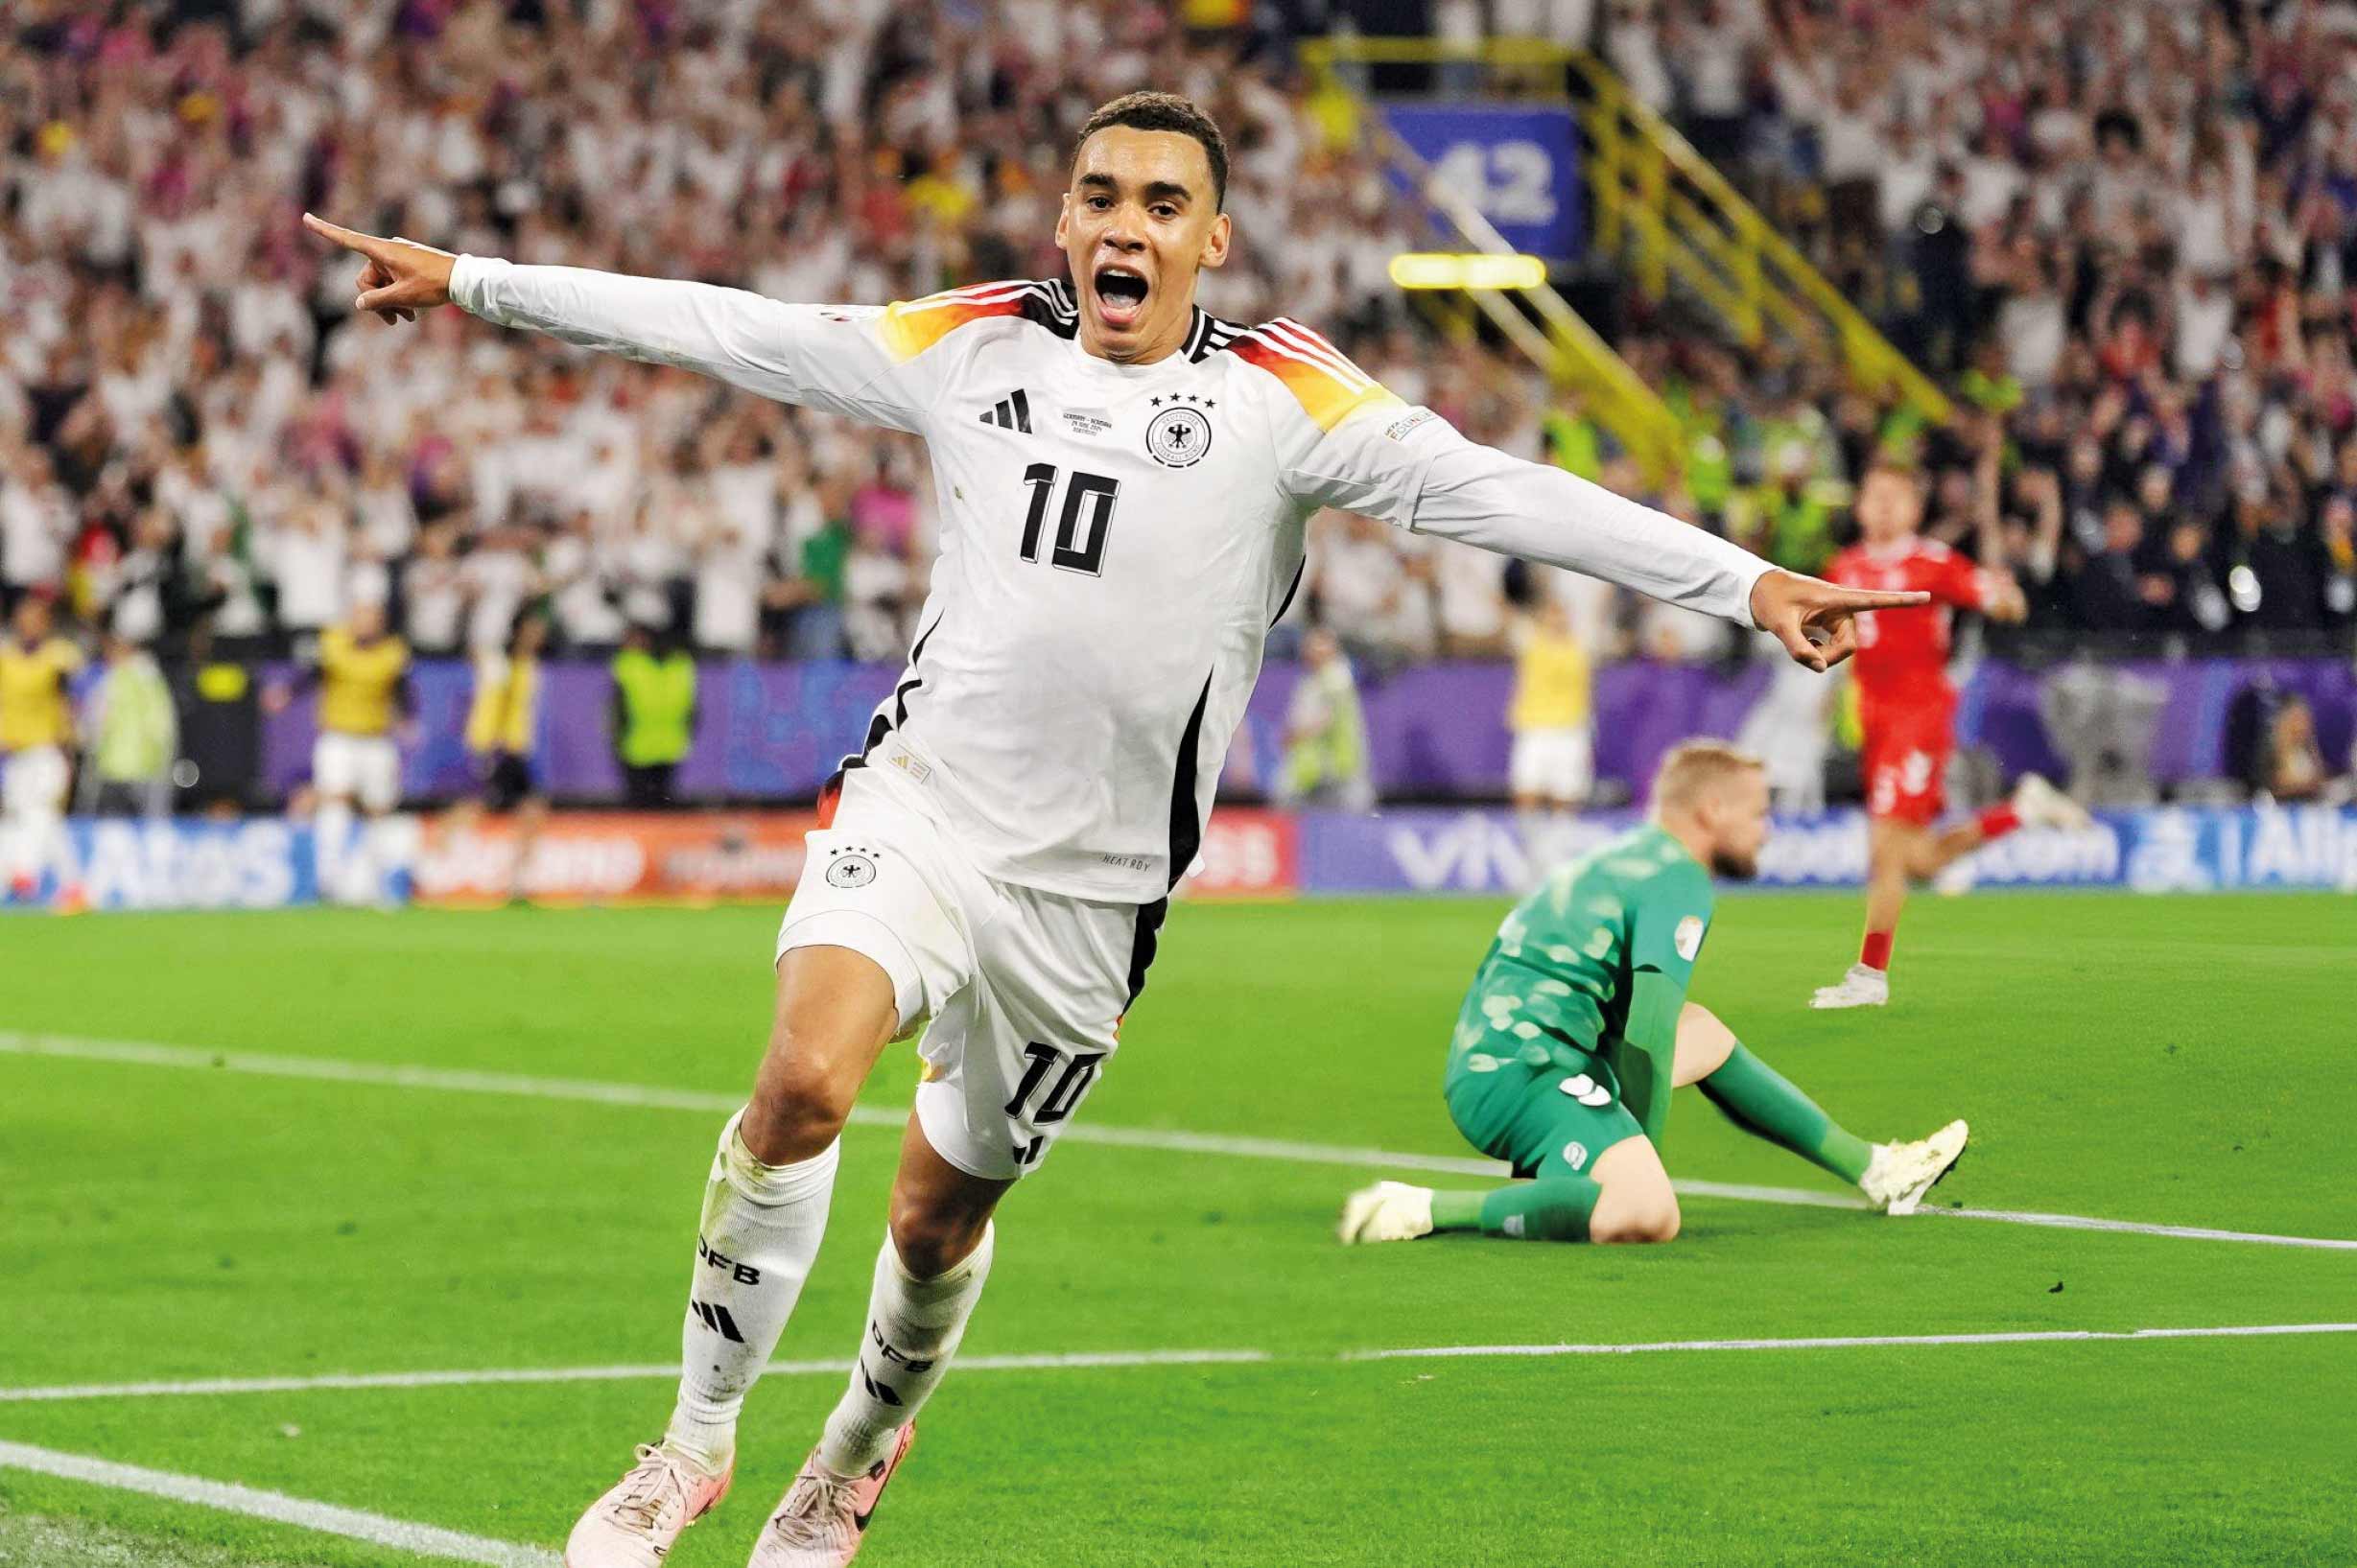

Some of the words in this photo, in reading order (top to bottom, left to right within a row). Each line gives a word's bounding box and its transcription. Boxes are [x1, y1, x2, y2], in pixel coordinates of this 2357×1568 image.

[1429, 141, 1559, 222] 42
[1020, 462, 1121, 578] 10
[1004, 1041, 1108, 1127] 10
